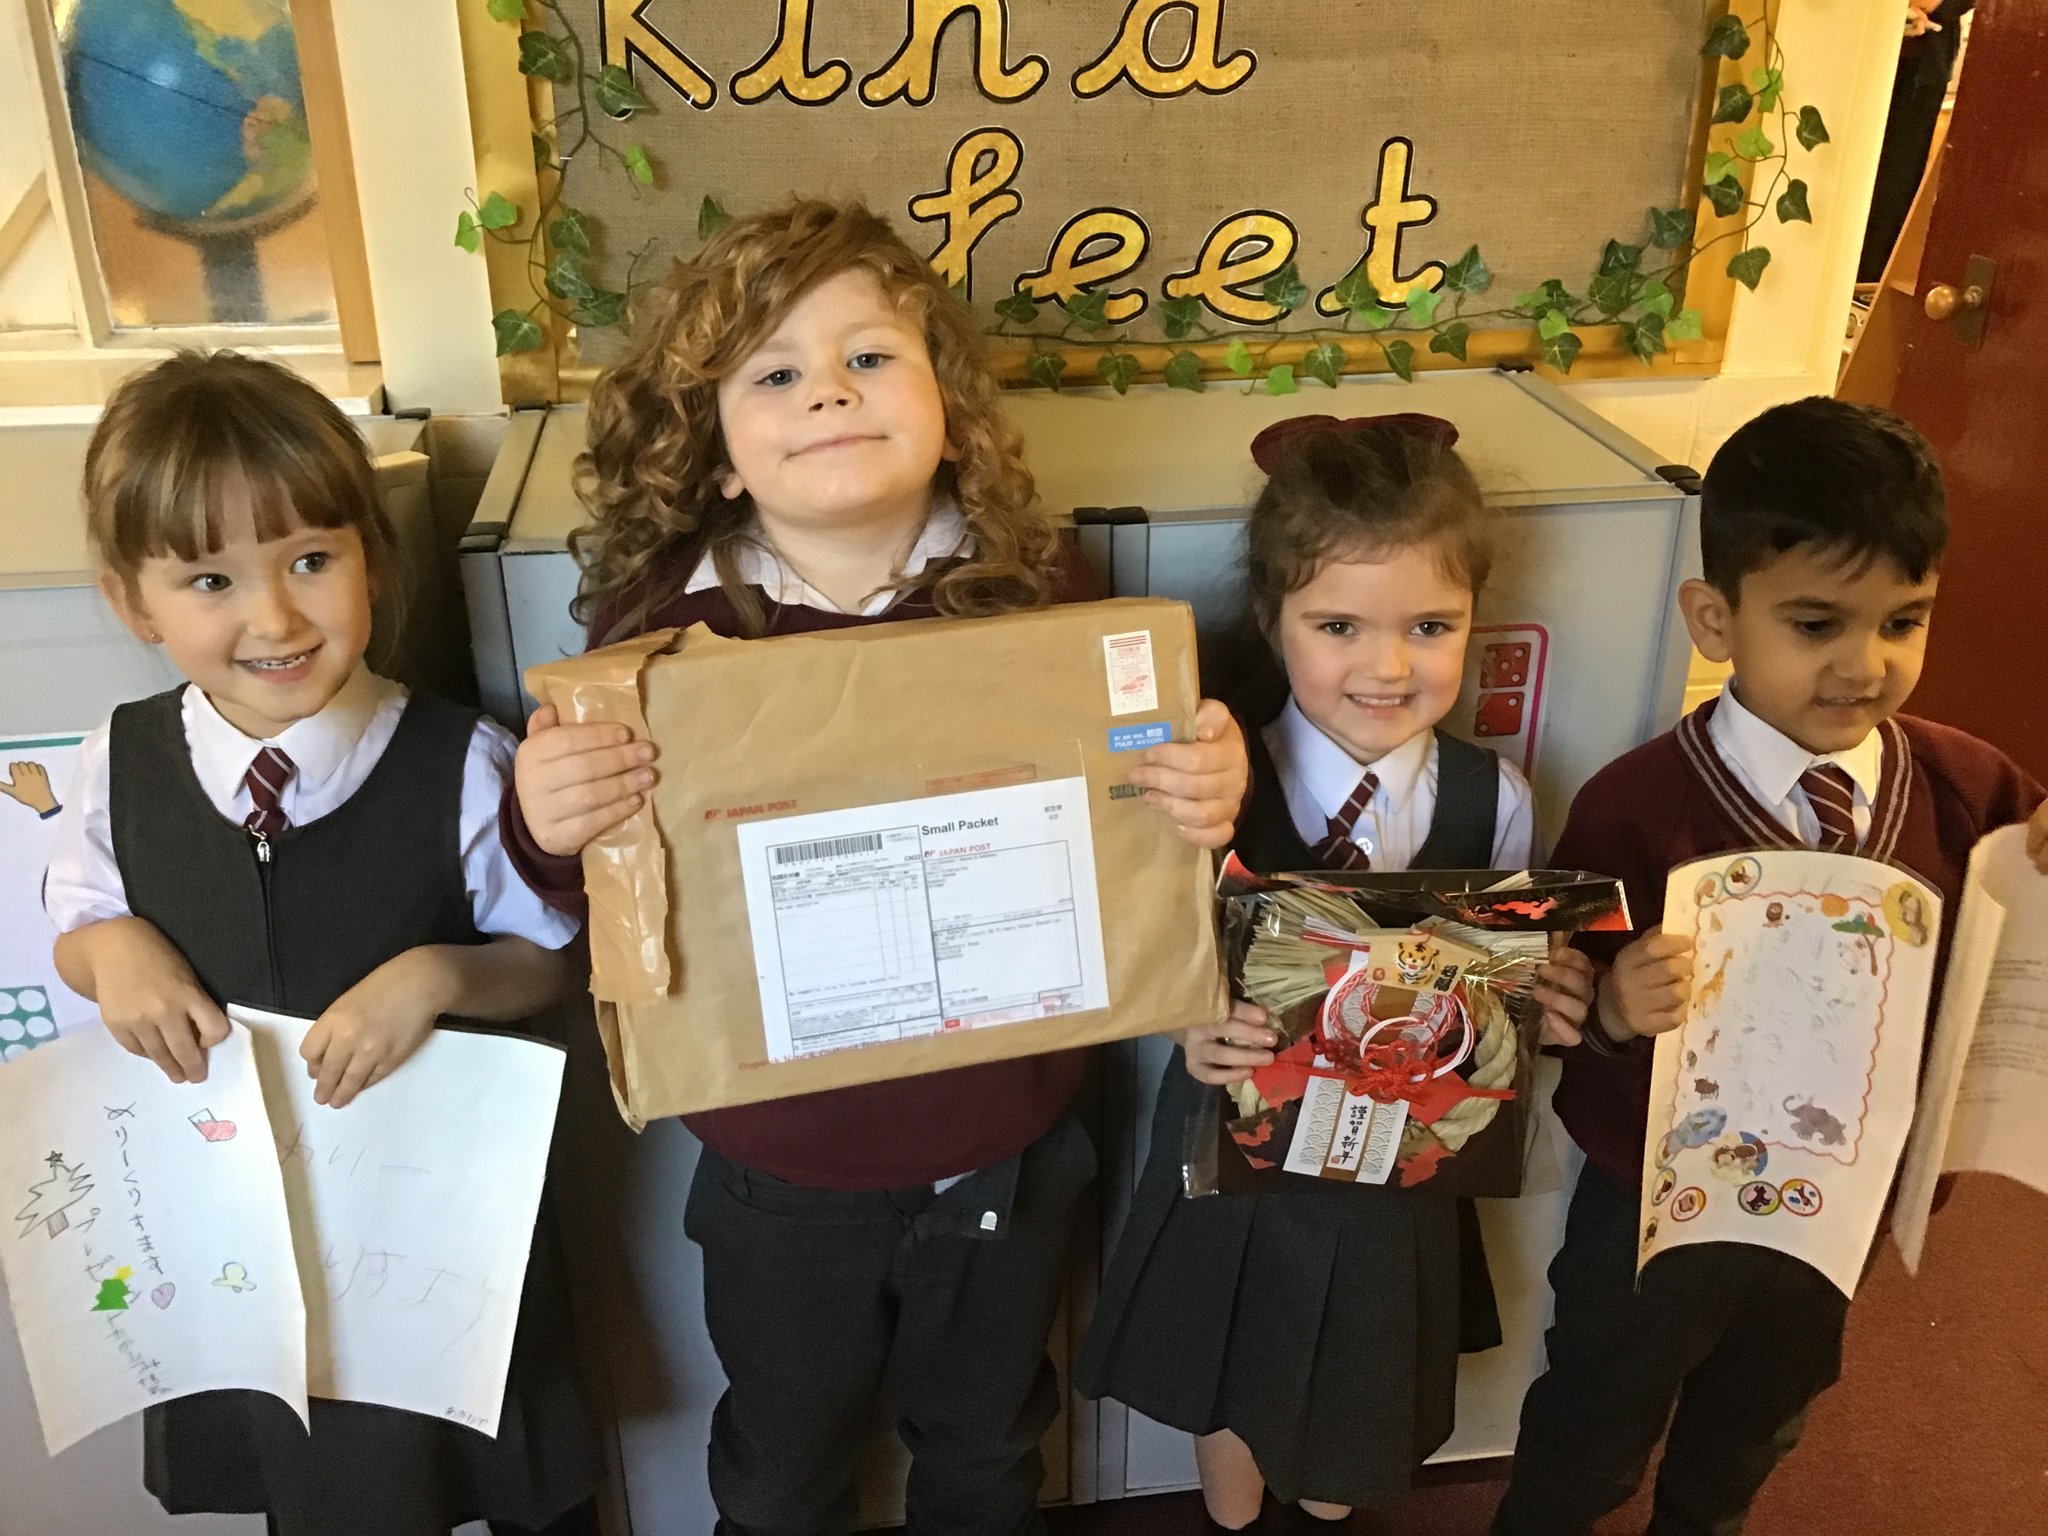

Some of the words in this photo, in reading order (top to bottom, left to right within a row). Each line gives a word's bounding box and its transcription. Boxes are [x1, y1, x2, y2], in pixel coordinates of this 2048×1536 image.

[908, 126, 1448, 325] feet
[1114, 740, 1133, 748] PAR
[1136, 737, 1164, 745] AVION
[726, 804, 763, 818] JAPAN
[767, 799, 797, 812] POST
[921, 821, 955, 836] Small
[958, 816, 999, 831] Packet
[938, 846, 967, 857] JAPAN
[969, 842, 991, 852] POST
[1335, 1104, 1368, 1165] 謹賀新年
